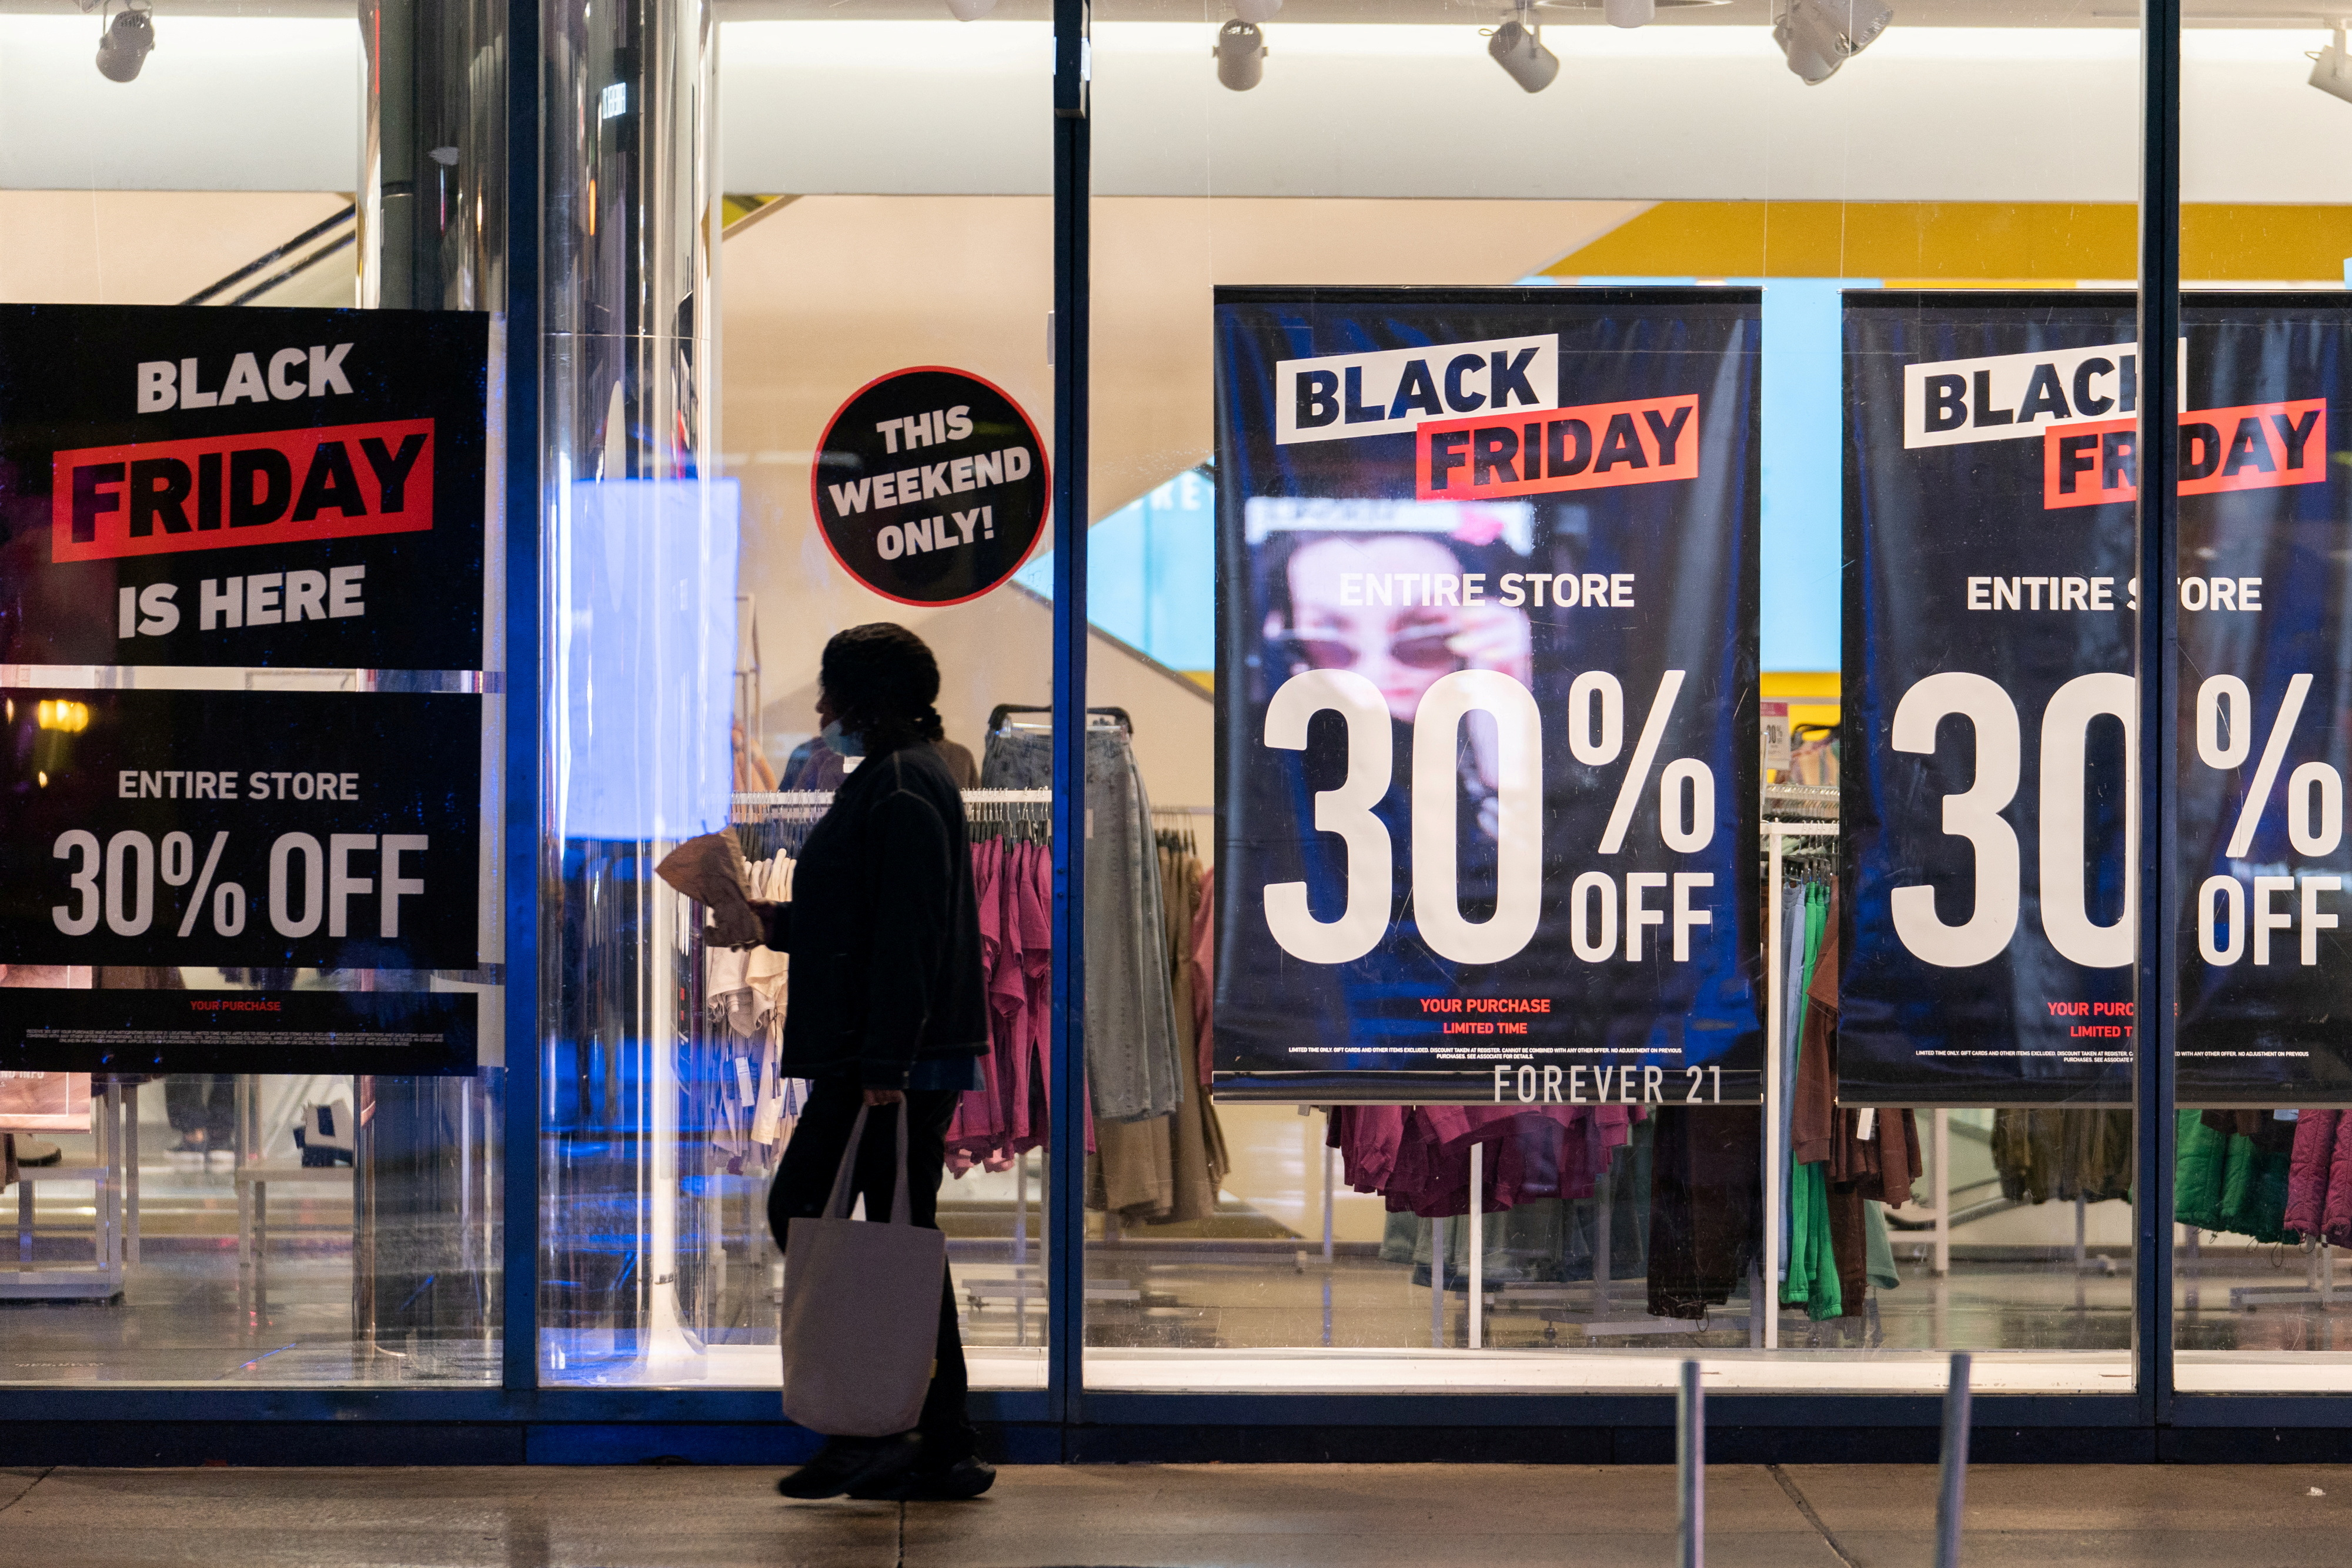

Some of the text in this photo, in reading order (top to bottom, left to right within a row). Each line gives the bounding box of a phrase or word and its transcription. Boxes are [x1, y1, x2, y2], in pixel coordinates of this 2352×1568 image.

[138, 343, 353, 413] BLACK
[1295, 347, 1540, 430] BLACK
[876, 404, 974, 454] THIS
[1430, 406, 1693, 490] FRIDAY
[2059, 410, 2321, 494] FRDAY
[72, 433, 429, 544] FRIDAY
[828, 446, 1031, 517] WEEKEND
[876, 505, 994, 560] ONLY!
[119, 565, 365, 638] IS HERE
[1339, 573, 1635, 608] ENTIRE STORE
[1967, 576, 2263, 611] ENTIRE ORE
[119, 770, 359, 800] ENTIRE STORE
[1264, 668, 1715, 964] 30%
[1891, 672, 2343, 968] 30%
[52, 829, 429, 938] 30% OFF
[1571, 871, 1714, 963] OFF
[2199, 875, 2342, 966] OFF
[191, 1001, 280, 1011] YOUR PURCHASE
[1421, 998, 1551, 1013] YOUR PURCHASE
[1444, 1022, 1528, 1034] LIMITED TIME
[2047, 1002, 2089, 1016] YOUR
[2070, 1025, 2122, 1038] LIMITED
[1494, 1065, 1720, 1104] FOREVER 21
